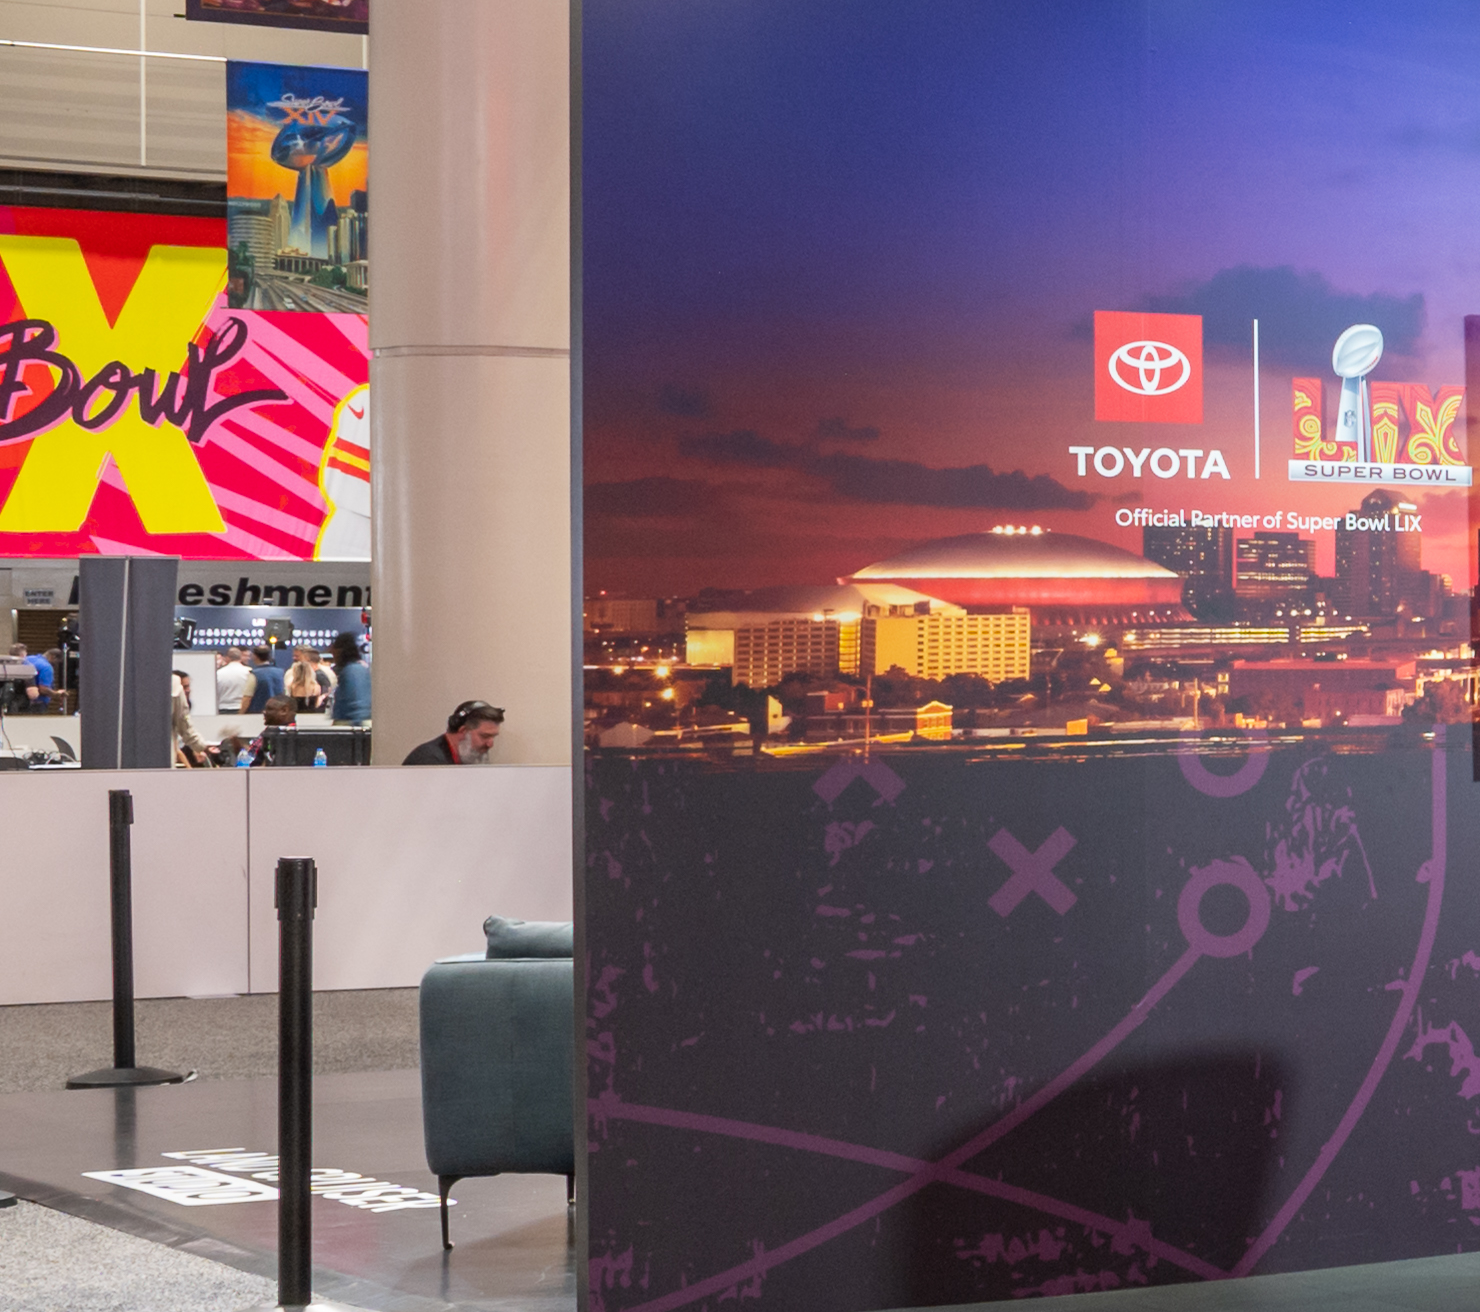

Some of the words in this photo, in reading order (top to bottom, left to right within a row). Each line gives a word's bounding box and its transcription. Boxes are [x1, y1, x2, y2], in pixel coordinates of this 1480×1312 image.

[1069, 445, 1231, 480] TOYOTA
[1304, 464, 1384, 480] SUPER
[1393, 468, 1457, 483] BOWL
[1115, 508, 1187, 528] Official
[1191, 510, 1261, 531] Partner
[1263, 510, 1283, 530] of
[1286, 512, 1342, 535] Super
[1346, 514, 1391, 533] Bowl
[1394, 515, 1423, 533] LIX
